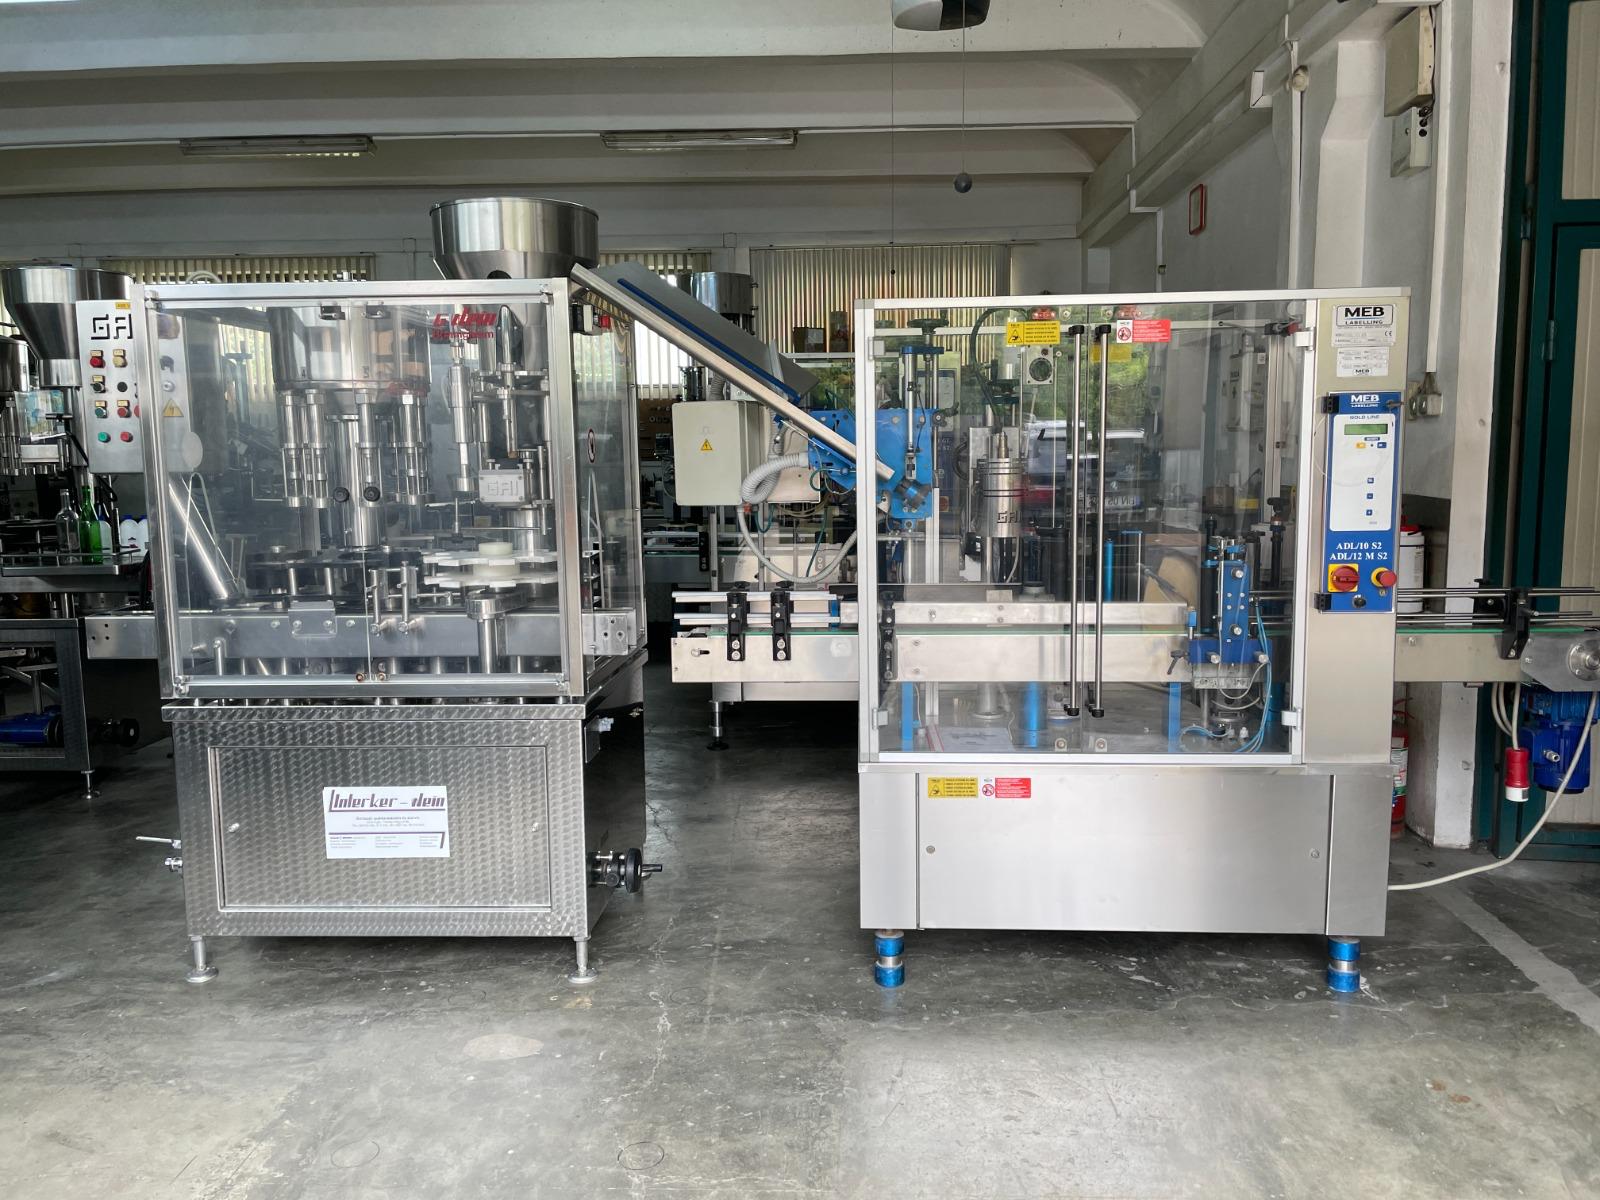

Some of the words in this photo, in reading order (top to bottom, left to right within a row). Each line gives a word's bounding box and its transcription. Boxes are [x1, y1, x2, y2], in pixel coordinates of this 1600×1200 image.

[1344, 306, 1385, 317] MEB
[1351, 394, 1380, 402] MEB
[1336, 541, 1369, 550] ADL/10
[1371, 541, 1382, 550] S2
[1329, 552, 1363, 561] ADL/12
[1365, 552, 1375, 560] M
[1377, 551, 1388, 560] S2
